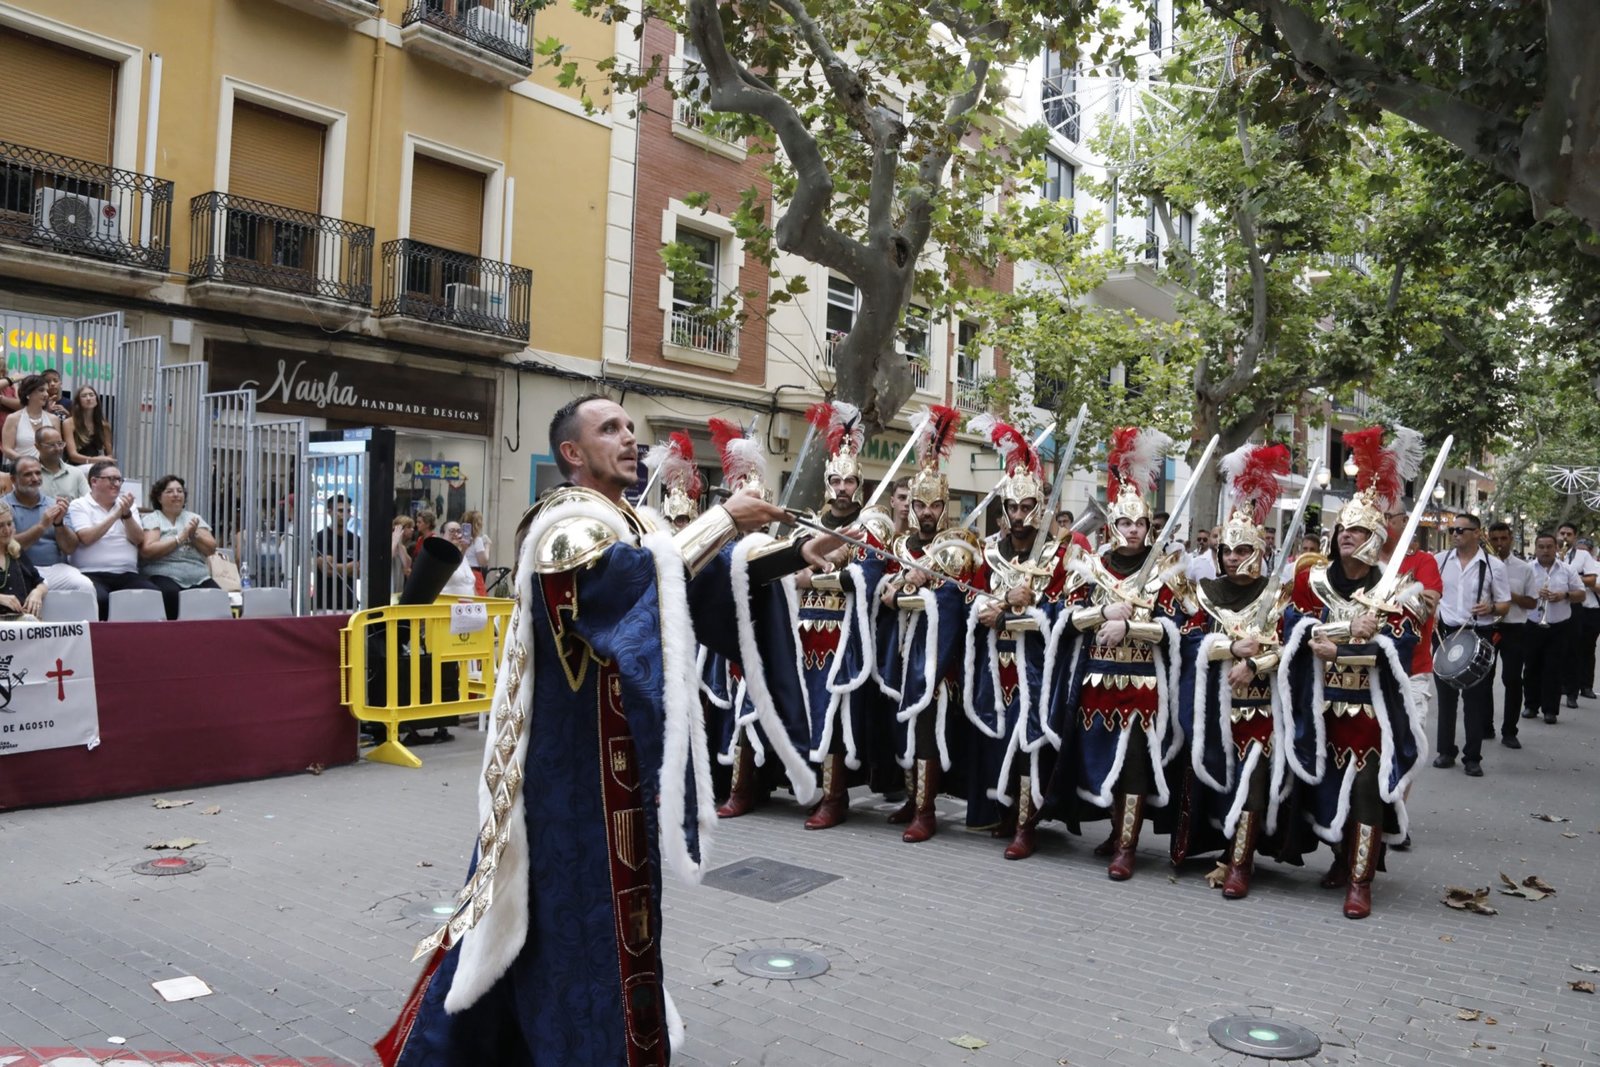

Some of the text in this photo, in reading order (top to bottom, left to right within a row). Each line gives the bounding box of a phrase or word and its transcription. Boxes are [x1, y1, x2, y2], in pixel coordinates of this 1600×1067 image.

[103, 218, 115, 228] LG
[239, 359, 479, 421] Naisha HANDMADE DESIGNS
[415, 461, 459, 478] Rebajas
[20, 628, 23, 640] I
[27, 624, 83, 639] CRISTIANS
[3, 720, 54, 733] DE AGOSTO
